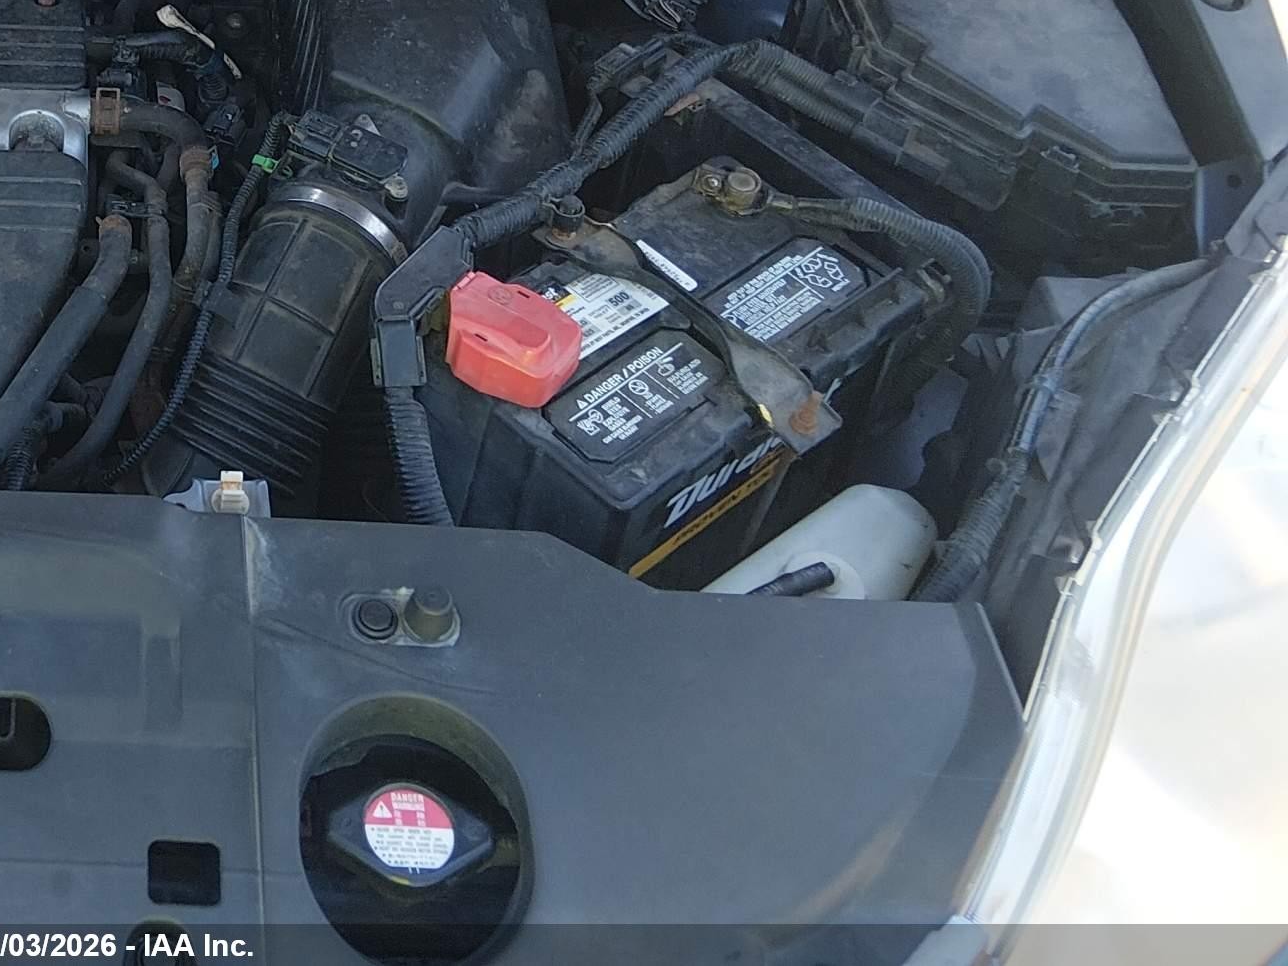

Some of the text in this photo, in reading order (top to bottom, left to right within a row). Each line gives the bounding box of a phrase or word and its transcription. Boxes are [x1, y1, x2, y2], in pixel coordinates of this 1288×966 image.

[608, 292, 630, 307] 500
[583, 373, 625, 404] DANGER
[627, 346, 665, 374] POISON
[390, 792, 425, 803] DANGER
